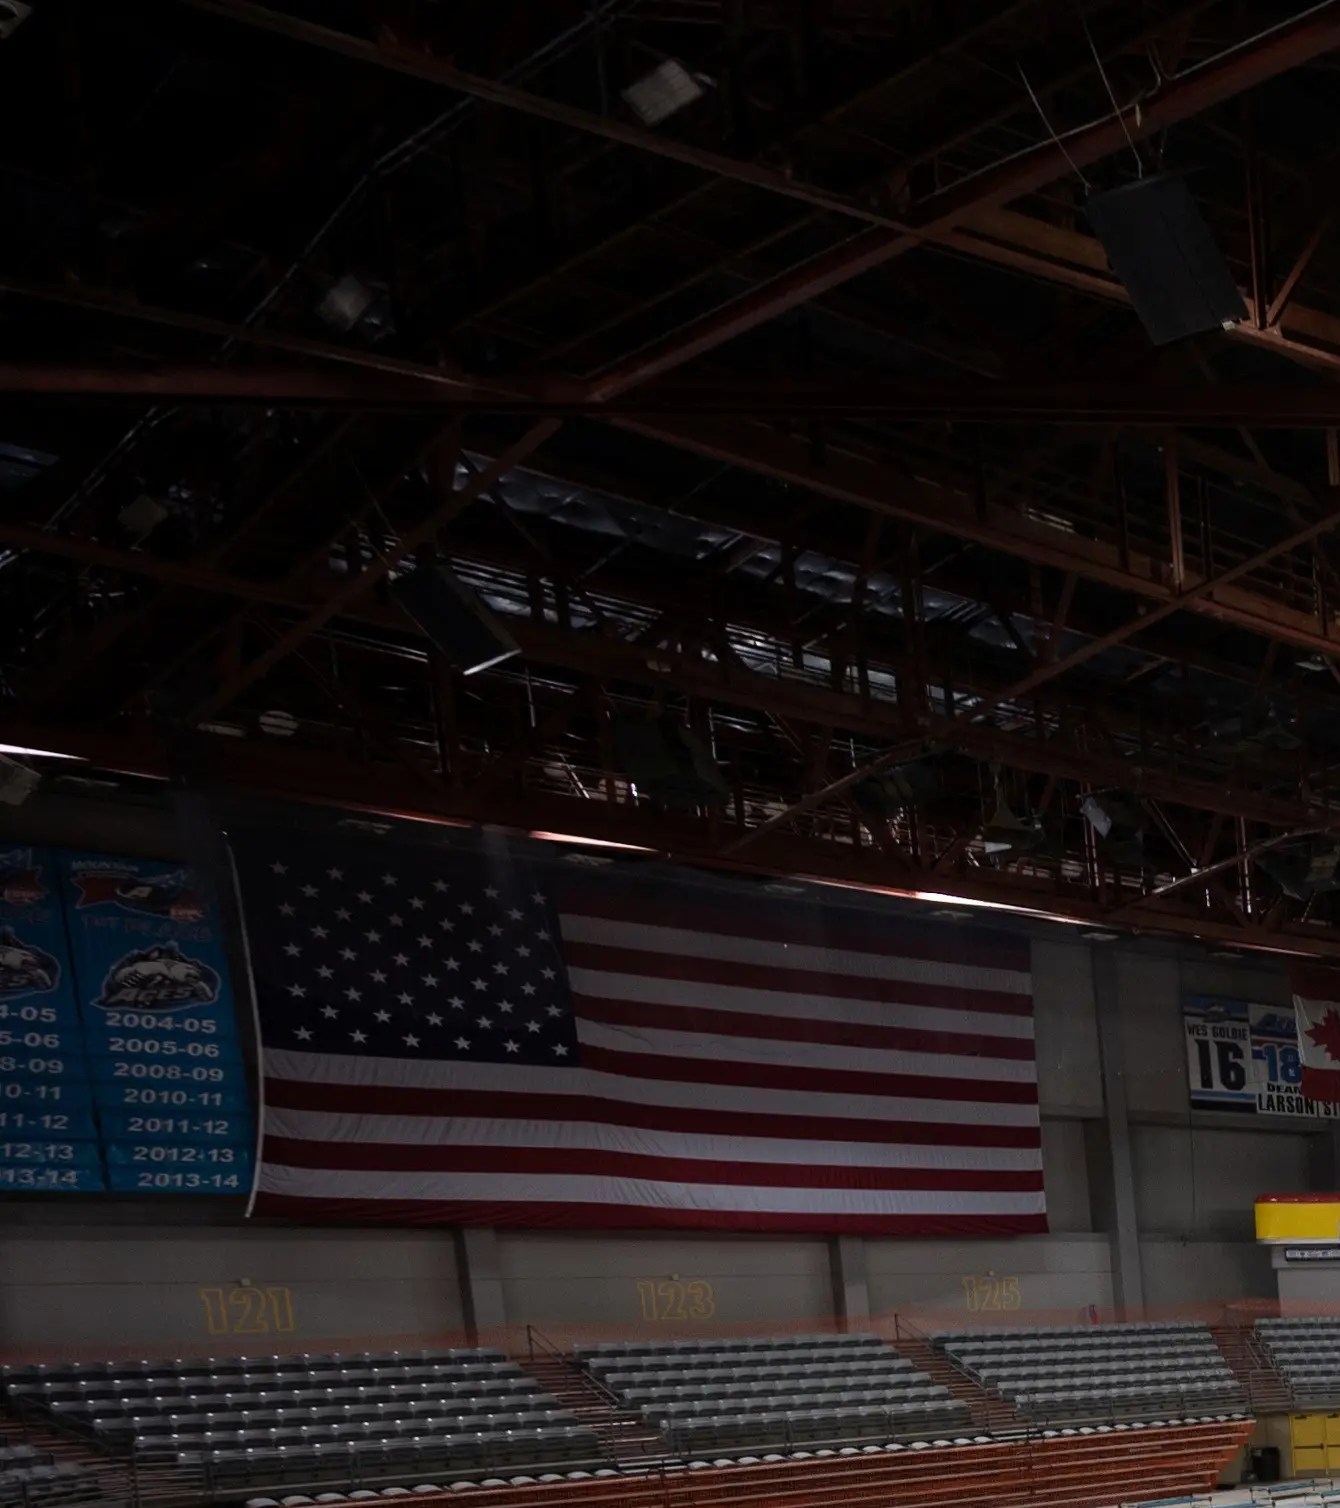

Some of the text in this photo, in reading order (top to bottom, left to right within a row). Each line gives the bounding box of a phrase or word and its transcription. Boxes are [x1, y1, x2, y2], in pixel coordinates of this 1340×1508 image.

[105, 1012, 217, 1034] 2004-05
[1187, 1023, 1208, 1037] WES
[108, 1037, 220, 1058] 2005-06
[113, 1062, 224, 1082] 2008-09
[1195, 1039, 1246, 1091] 16
[1262, 1045, 1302, 1083] 18
[123, 1088, 223, 1106] 2010-11
[1258, 1093, 1315, 1115] LARSON
[128, 1117, 229, 1135] 2011-12
[133, 1146, 235, 1163] 2012-13
[138, 1173, 239, 1188] 2013-14
[637, 1280, 716, 1321] 123
[960, 1276, 1022, 1312] 125
[198, 1286, 296, 1334] 121
